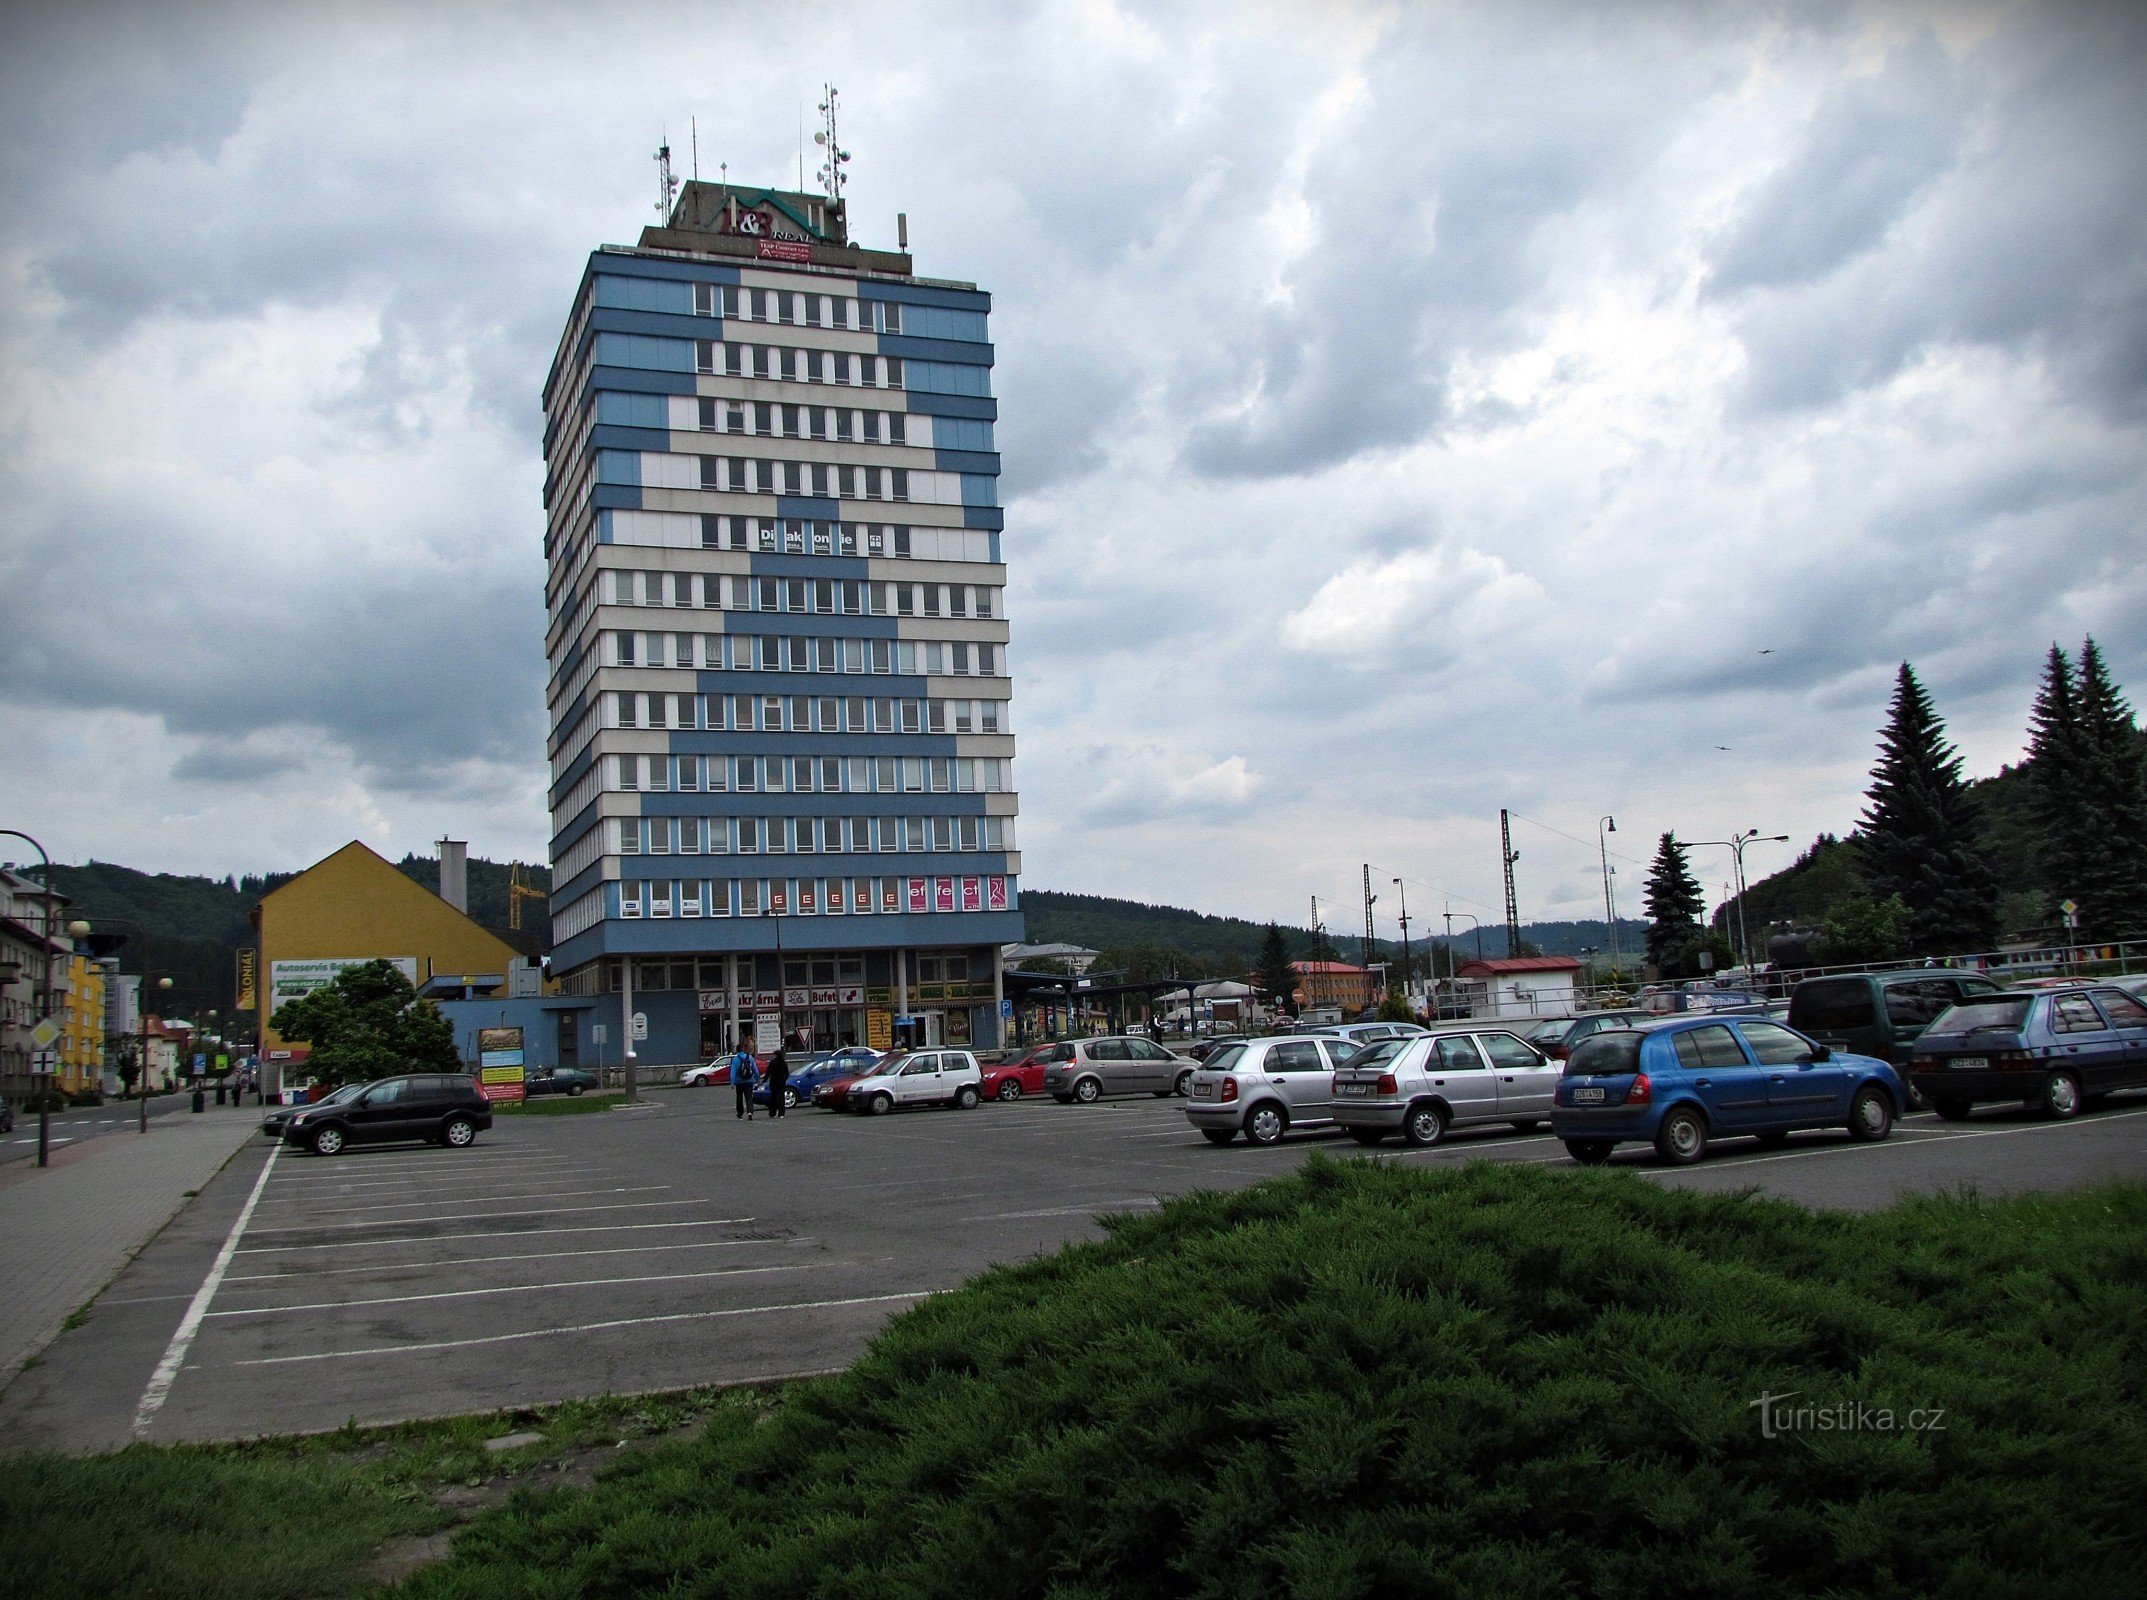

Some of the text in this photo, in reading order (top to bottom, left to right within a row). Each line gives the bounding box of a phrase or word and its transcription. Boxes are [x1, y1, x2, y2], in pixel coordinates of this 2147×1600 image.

[773, 231, 813, 243] REAL
[276, 962, 328, 972] Autoservis
[729, 993, 780, 1006] krárna
[812, 991, 837, 1003] Bufet
